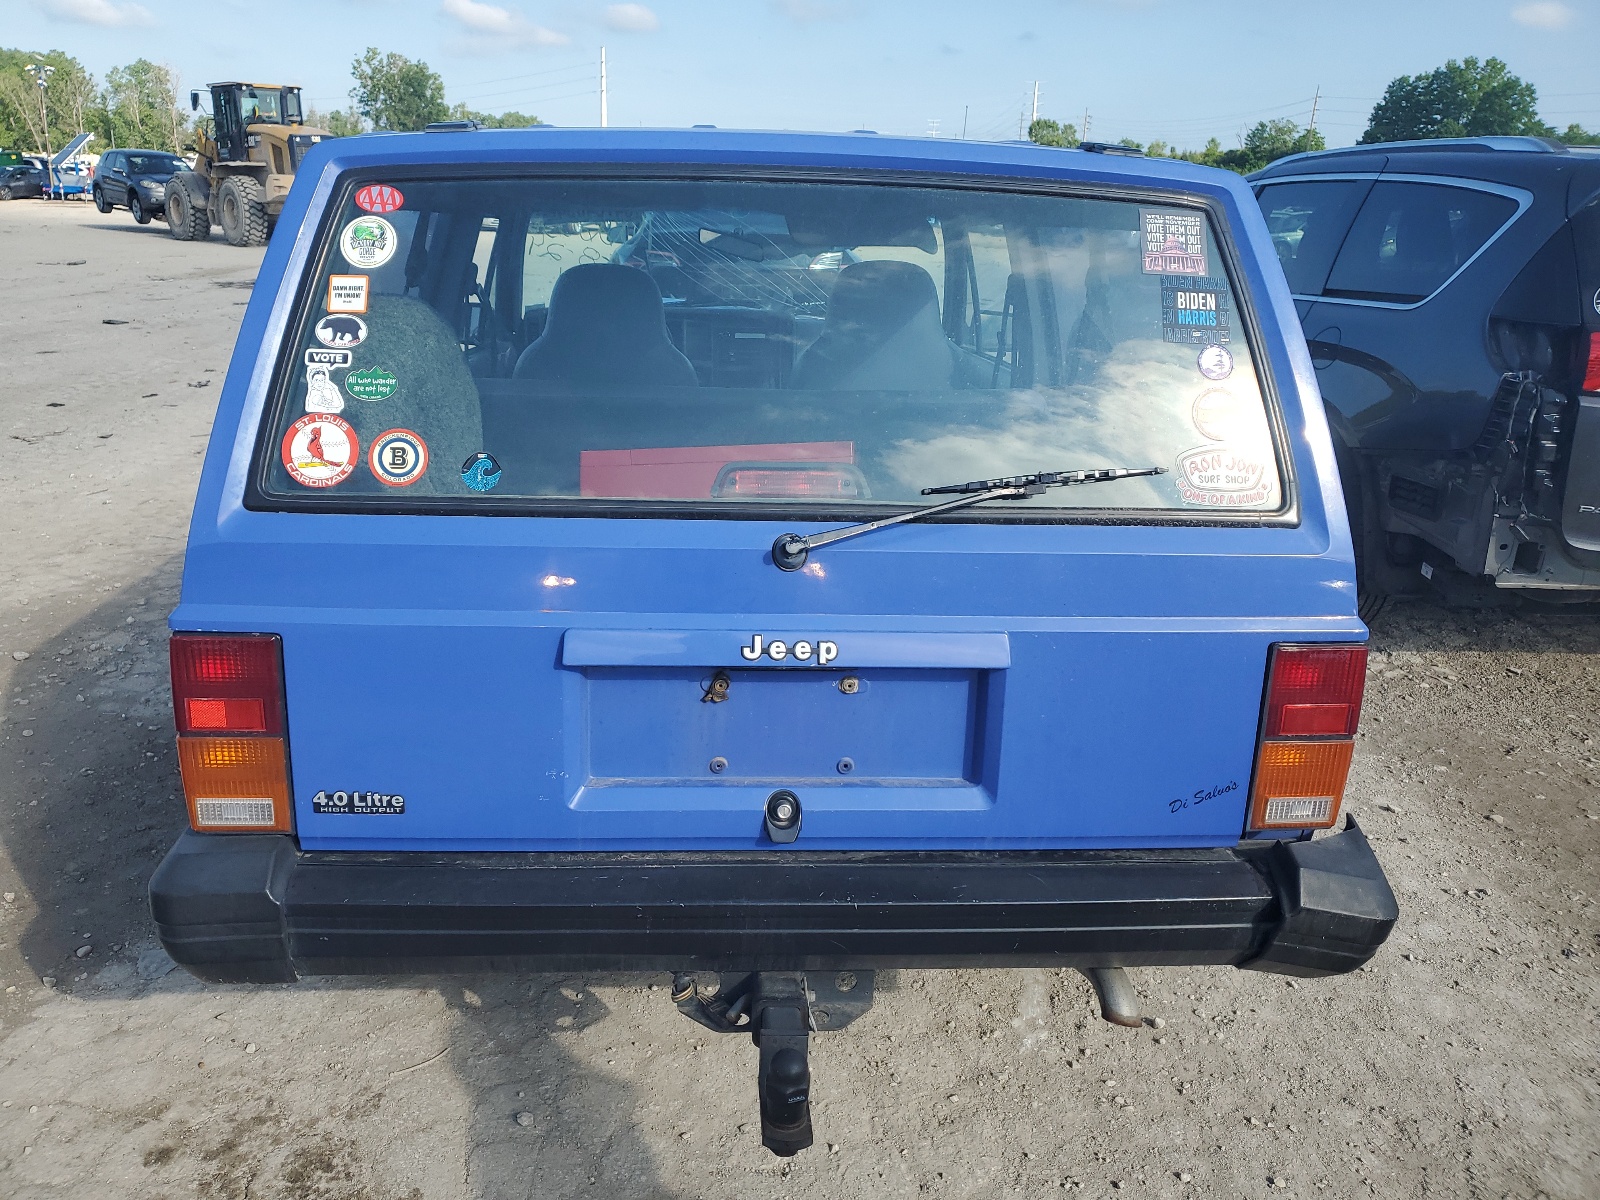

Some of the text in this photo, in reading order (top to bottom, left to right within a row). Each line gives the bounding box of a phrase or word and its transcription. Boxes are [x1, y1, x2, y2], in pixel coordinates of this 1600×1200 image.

[360, 186, 400, 212] AAA
[1146, 224, 1201, 236] VOTE THEM OUT
[1147, 232, 1164, 242] VOTE
[1188, 236, 1201, 244] OUT
[1188, 245, 1201, 254] OUT
[1178, 292, 1216, 310] BIDEN
[1178, 310, 1216, 326] HARRIS
[312, 352, 344, 362] VOTE
[366, 386, 376, 394] not
[378, 384, 391, 394] lost
[294, 414, 350, 431] ST. LOUIS
[388, 446, 408, 469] B
[1188, 455, 1258, 475] RON JON
[286, 462, 353, 488] CARDINALS
[382, 472, 414, 482] COLORADO
[1198, 474, 1250, 484] SURF SHOP
[1210, 494, 1226, 504] OF
[1228, 494, 1236, 504] A
[741, 634, 838, 665] Jeep
[312, 791, 404, 807] 4.0 Litre
[1168, 780, 1239, 814] Di Salvo's
